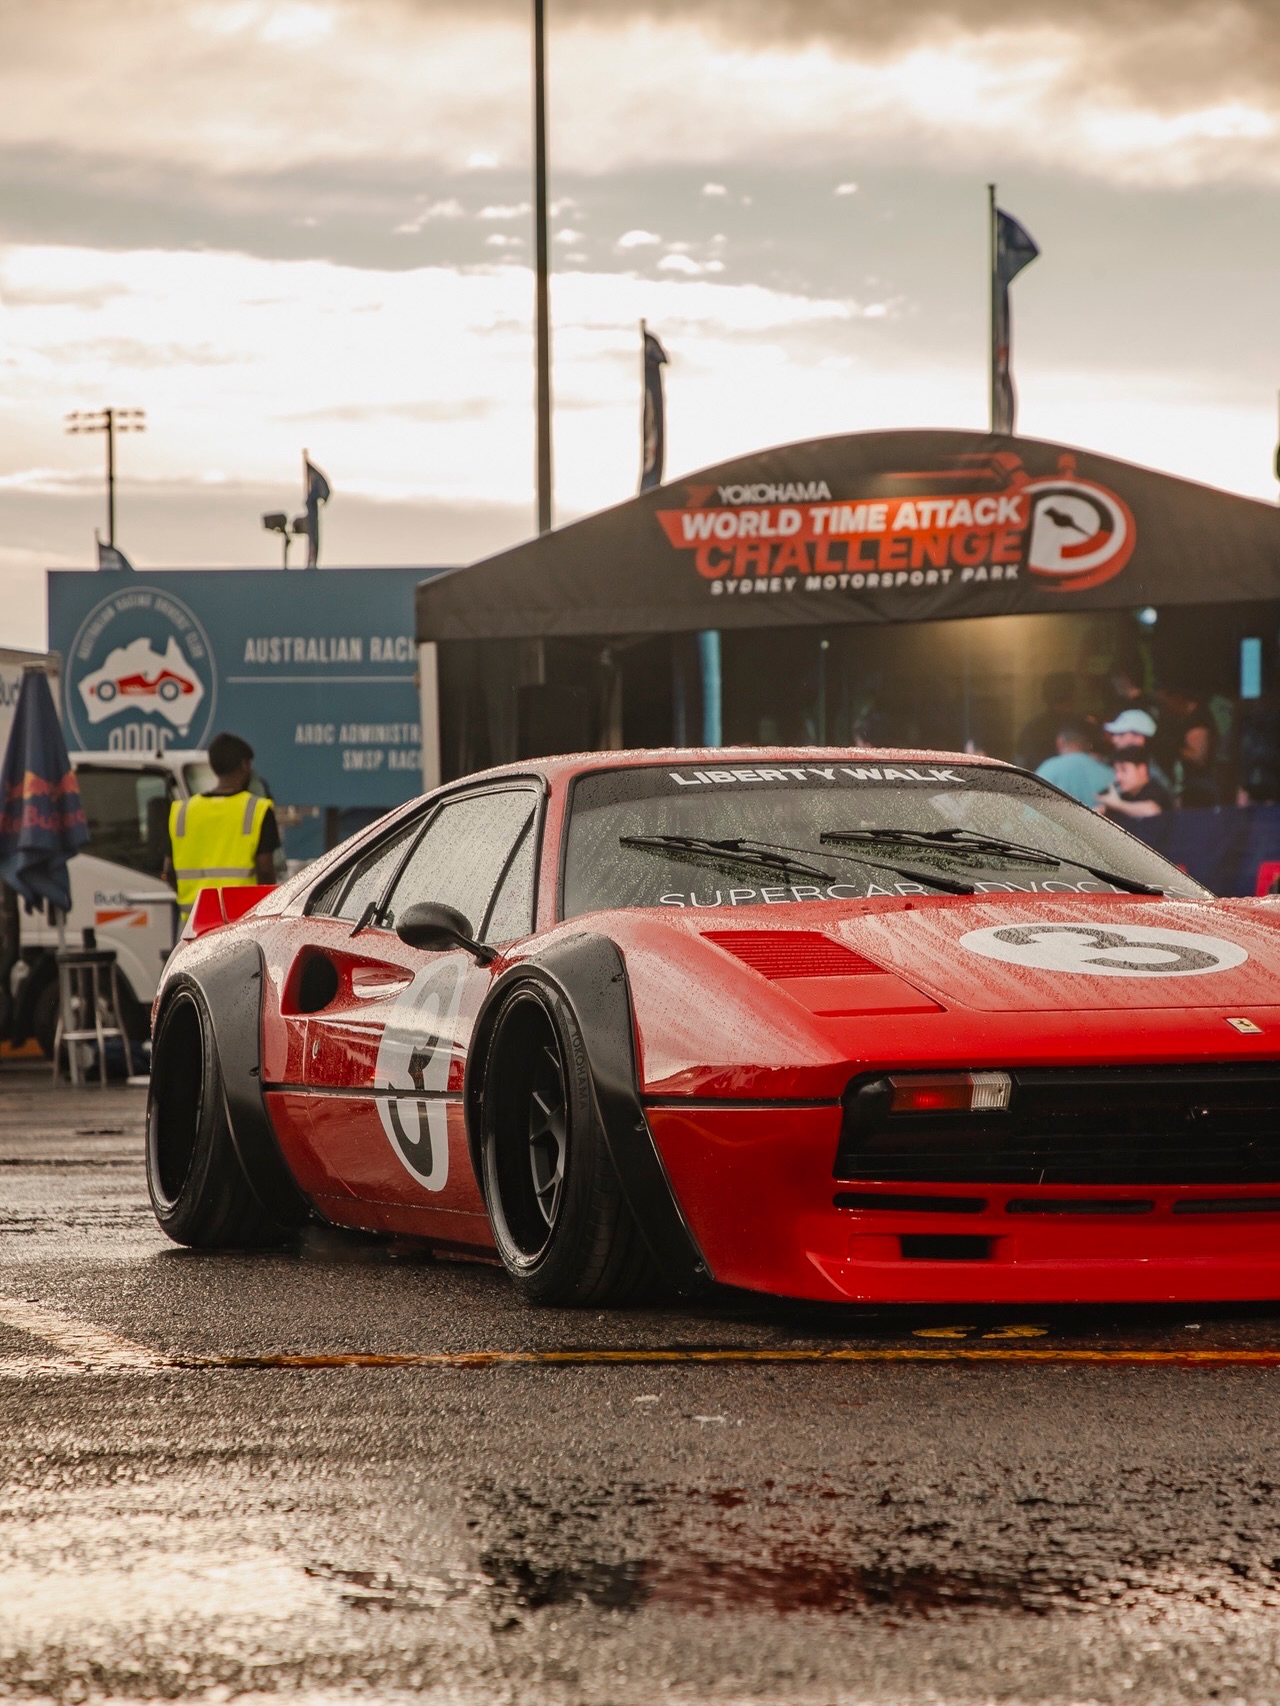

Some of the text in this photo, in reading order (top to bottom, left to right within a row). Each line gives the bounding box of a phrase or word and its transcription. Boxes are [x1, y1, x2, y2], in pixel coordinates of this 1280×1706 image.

[717, 480, 832, 504] YOKOHAMA
[682, 496, 1024, 541] WORLD TIME ATTACK
[694, 529, 1023, 579] CHALLENGE
[710, 563, 1019, 596] SYDNEY MOTORSPORT PARK
[244, 636, 363, 664] AUSTRALIAN
[669, 768, 967, 786] LIBERTY WALK
[659, 882, 931, 909] SUPERCAR
[993, 926, 1220, 972] 3
[570, 1029, 588, 1111] YOKOHAMA
